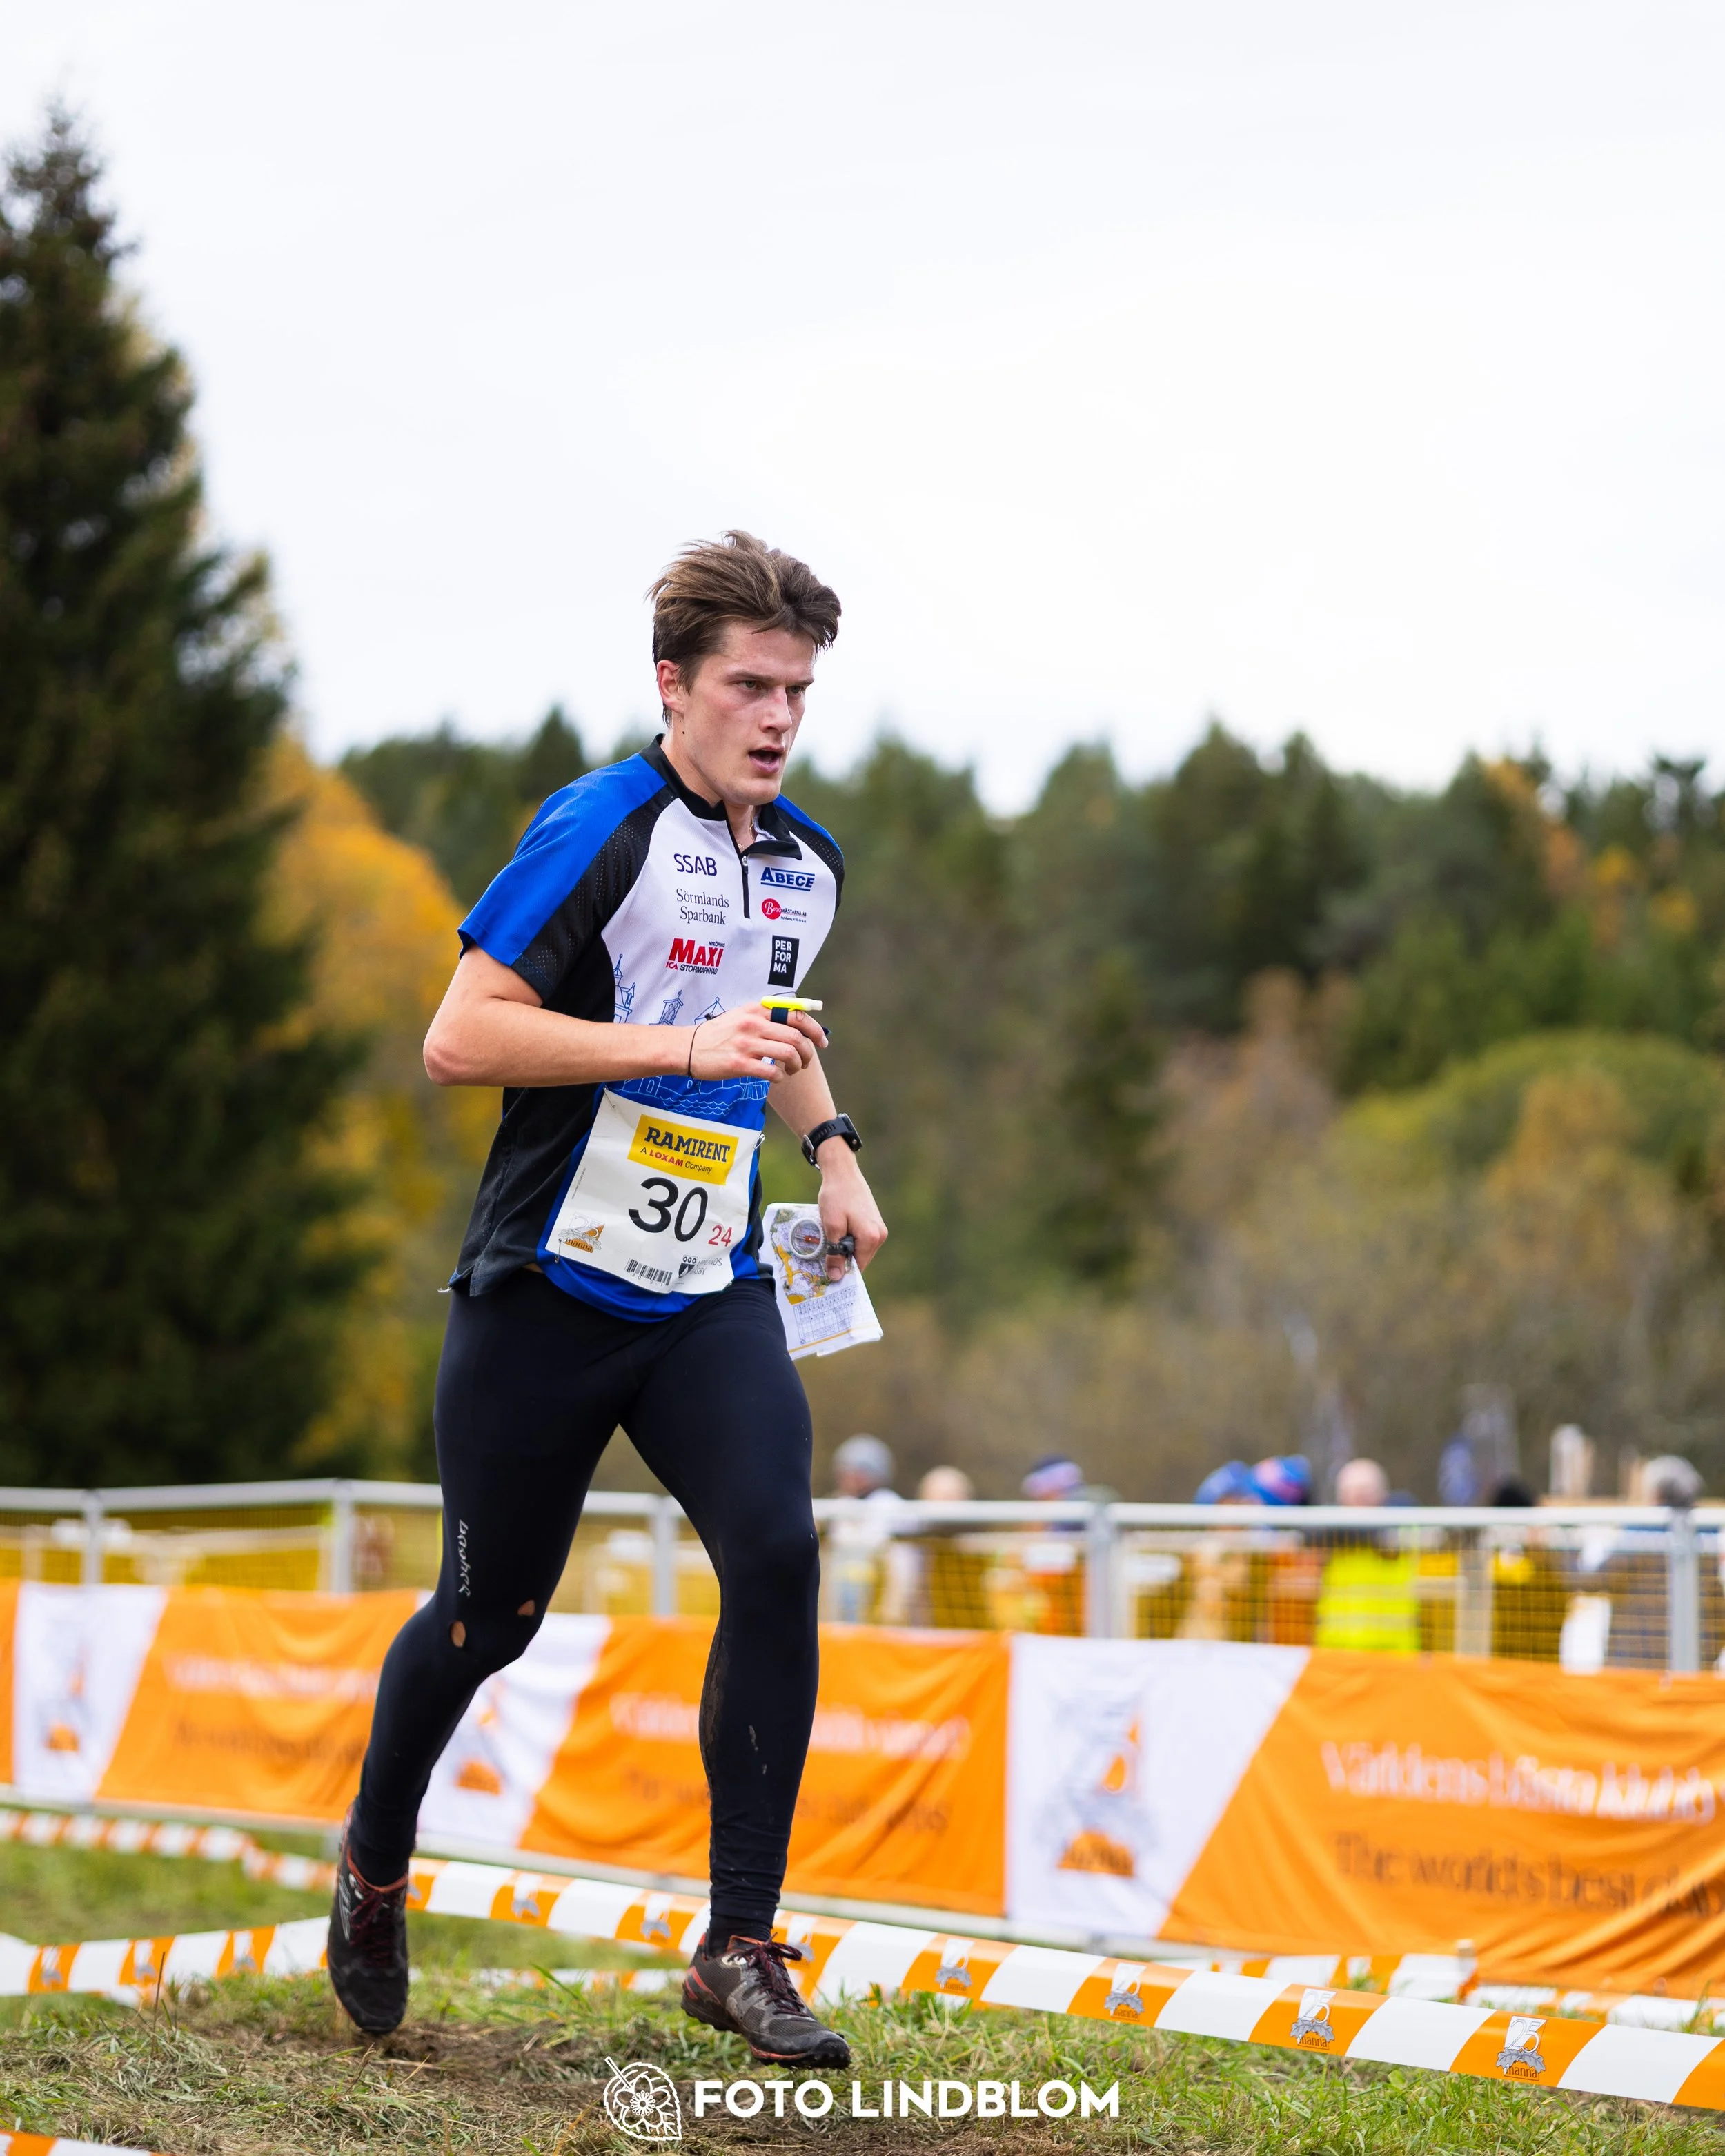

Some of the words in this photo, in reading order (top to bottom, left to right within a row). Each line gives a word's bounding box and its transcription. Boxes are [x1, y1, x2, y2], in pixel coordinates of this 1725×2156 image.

[673, 853, 717, 876] SSAB
[760, 867, 815, 888] ABECE
[676, 888, 729, 908] Sörmlands
[680, 906, 726, 925] Sparbank
[668, 938, 724, 967] MAXI
[775, 940, 792, 951] PER
[774, 951, 791, 962] FOR
[666, 961, 678, 970] ICA
[680, 964, 718, 975] STORMARKNAD
[773, 962, 787, 973] MA
[644, 1125, 731, 1163] RAMIRENT
[640, 1147, 647, 1155] A
[649, 1149, 684, 1167] LOXAM
[684, 1160, 712, 1174] Company
[628, 1177, 708, 1242] 30
[708, 1225, 733, 1247] 24
[1508, 2019, 1540, 2053] 25
